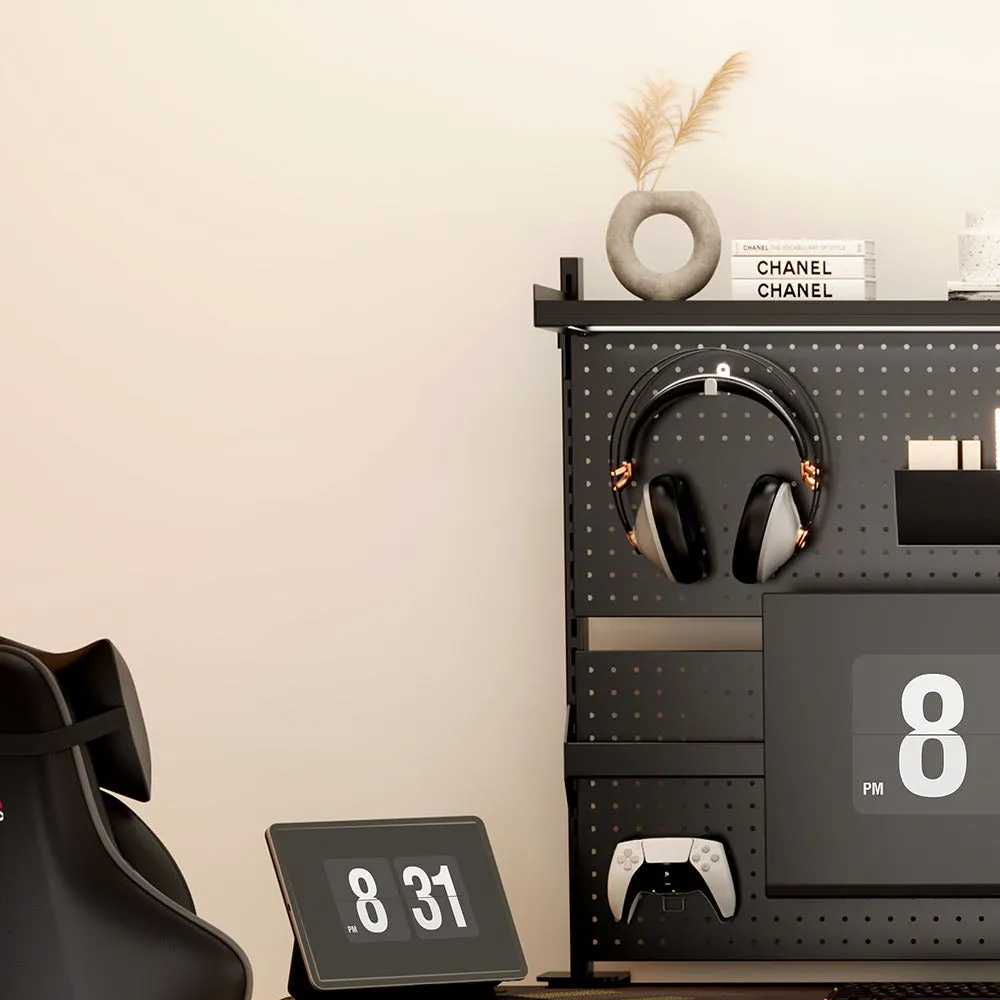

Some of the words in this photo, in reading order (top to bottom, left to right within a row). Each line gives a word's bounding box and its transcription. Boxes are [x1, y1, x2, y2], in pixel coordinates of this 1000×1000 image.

[757, 260, 832, 275] CHANEL
[758, 283, 833, 298] CHANEL
[899, 673, 968, 798] 8
[863, 782, 884, 796] PM
[348, 867, 389, 934] 8
[402, 865, 468, 931] 31
[347, 925, 358, 934] PM
